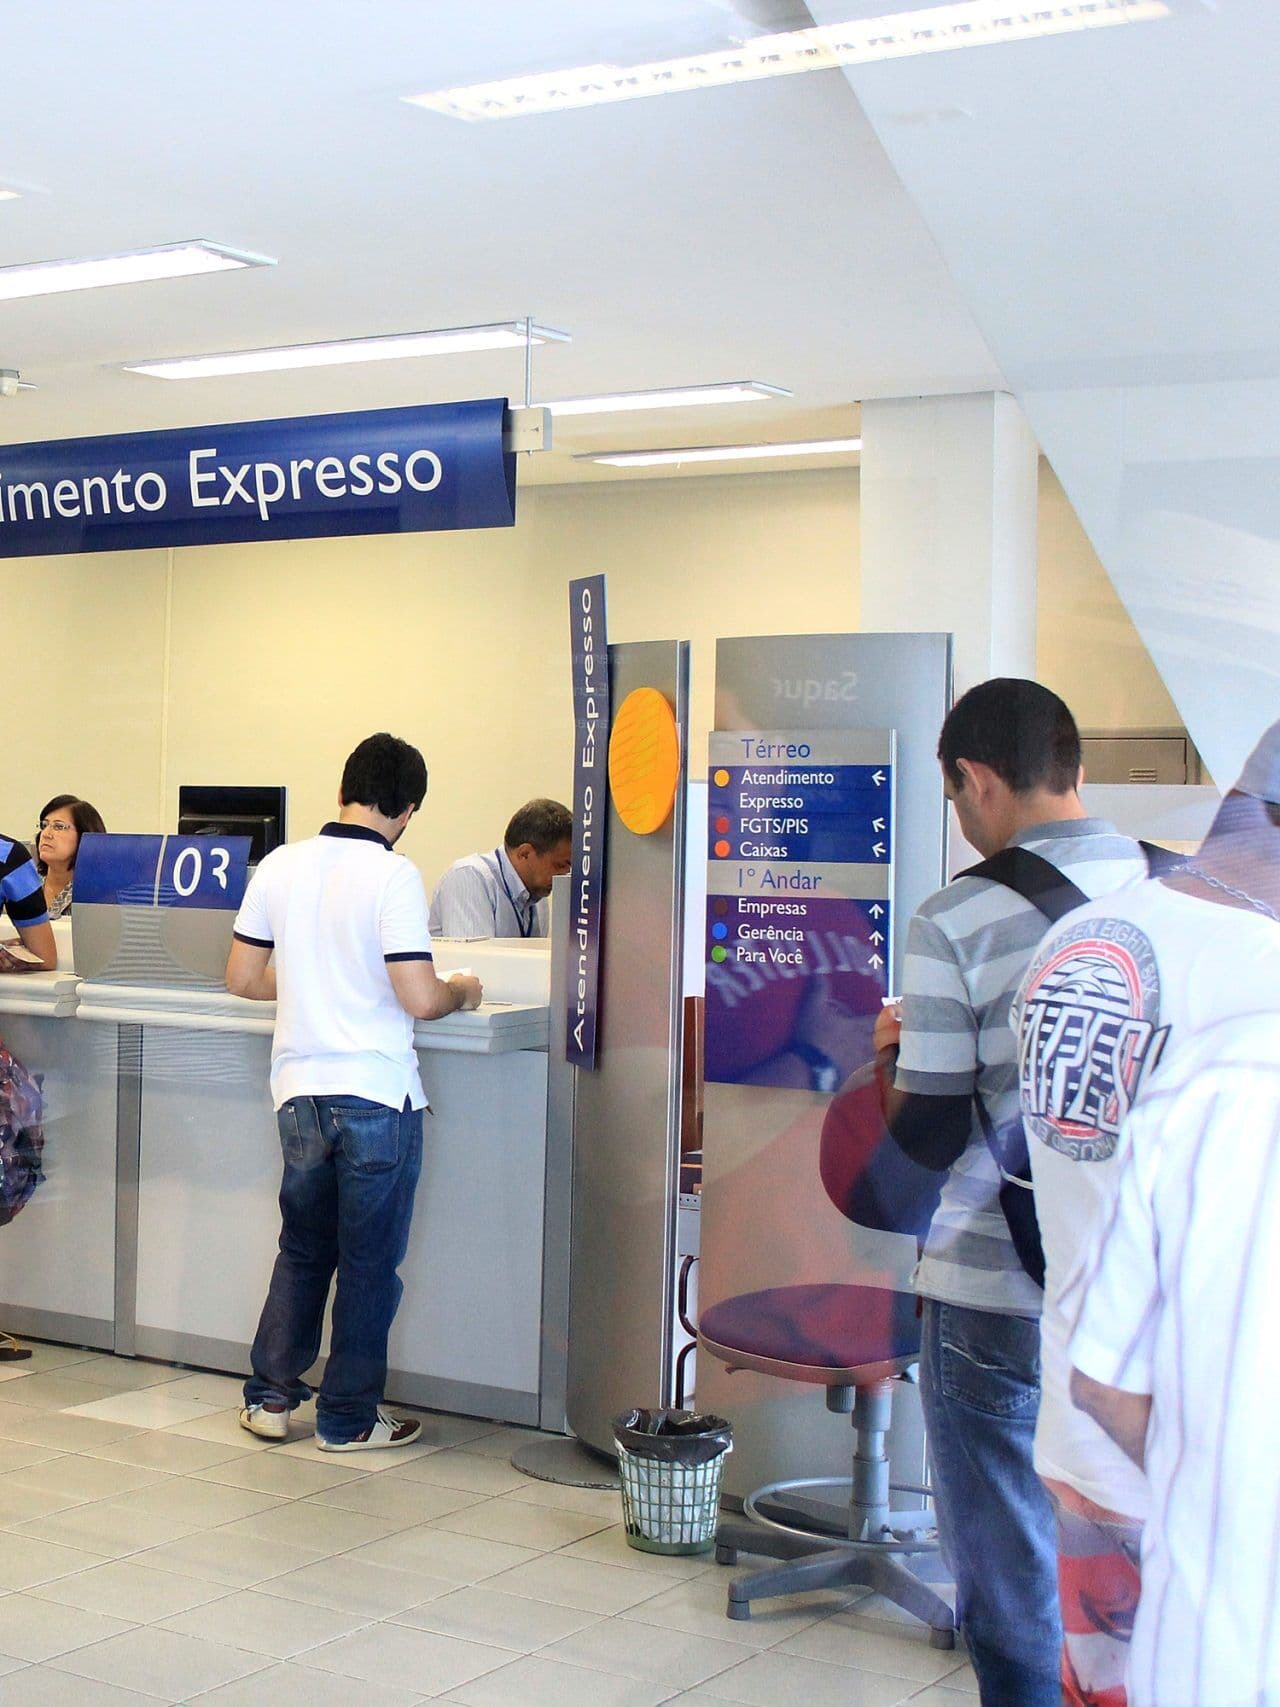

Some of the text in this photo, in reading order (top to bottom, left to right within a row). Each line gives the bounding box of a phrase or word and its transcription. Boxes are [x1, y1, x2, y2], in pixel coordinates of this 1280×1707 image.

[188, 448, 443, 521] Expresso
[581, 588, 599, 768] Expresso
[741, 738, 811, 759] Térreo
[741, 769, 835, 786] Atendimento
[740, 793, 804, 813] Expresso
[740, 818, 809, 835] FGTS/PIS
[740, 841, 788, 858] Caixas
[173, 847, 229, 896] 03
[760, 868, 822, 890] Andar
[573, 786, 593, 1051] Atendimento
[738, 898, 808, 919] Empresas
[737, 923, 805, 943] Gerência
[736, 946, 804, 965] Para Você
